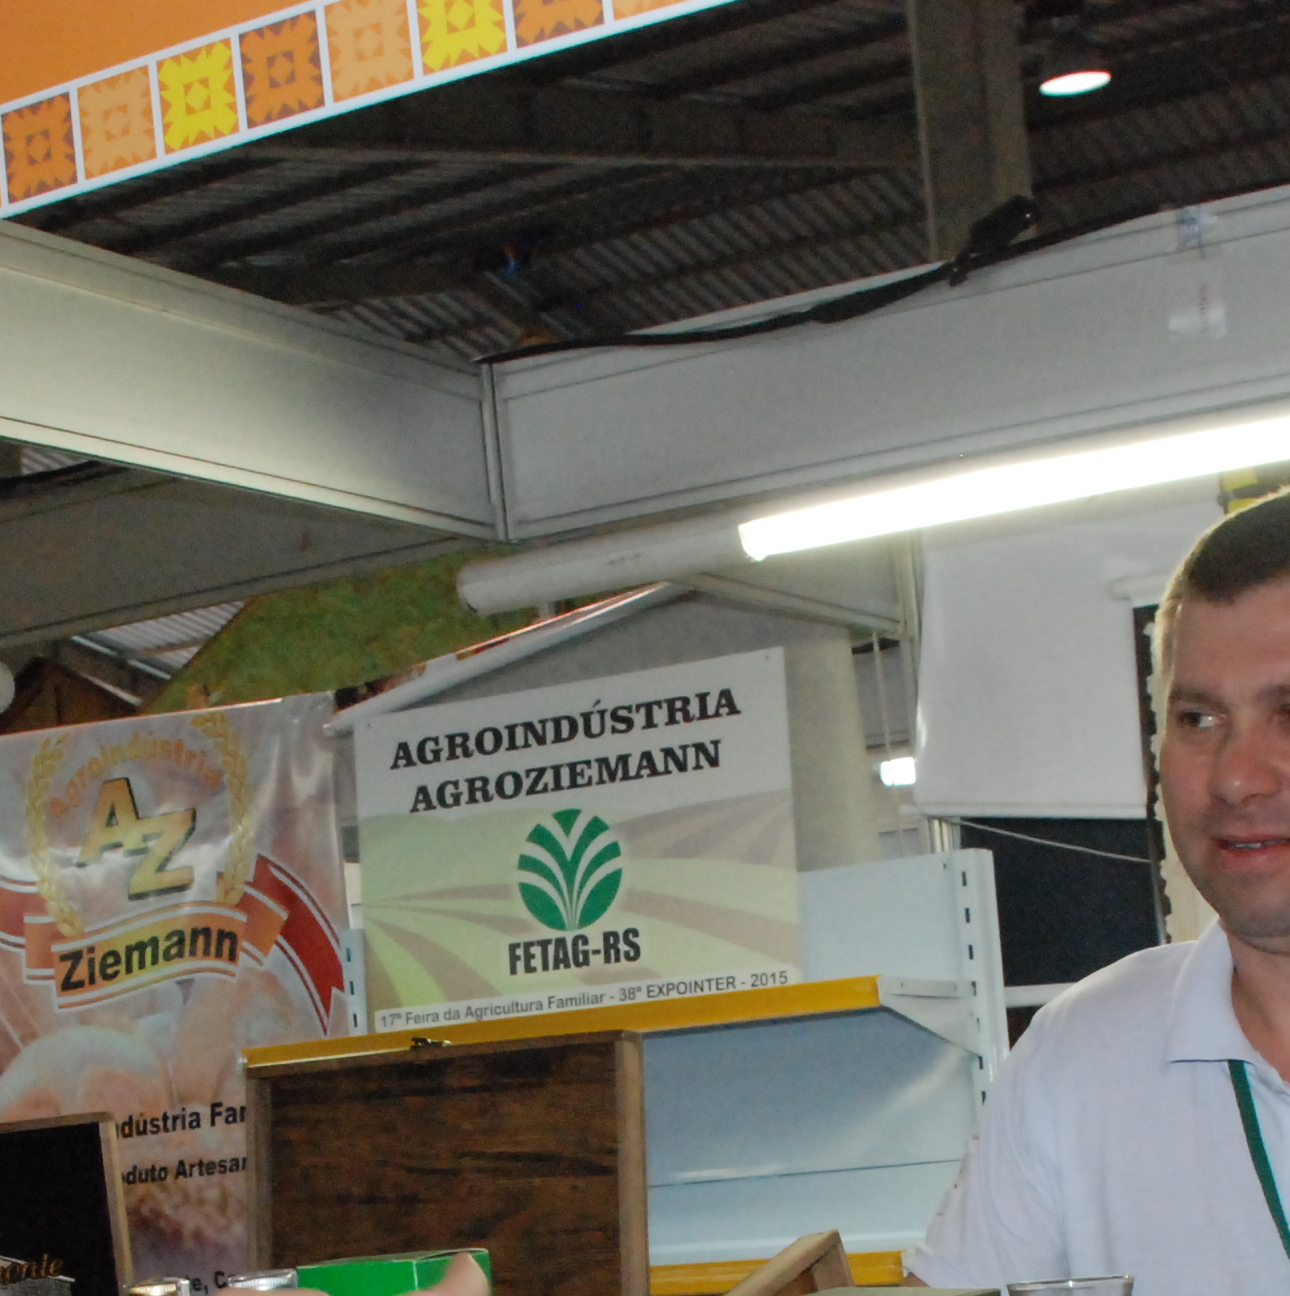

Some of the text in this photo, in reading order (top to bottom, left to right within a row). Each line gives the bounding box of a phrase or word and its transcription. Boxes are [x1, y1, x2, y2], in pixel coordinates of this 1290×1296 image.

[390, 688, 742, 770] AGROINDÚSTRIA
[410, 739, 722, 813] AGROZIEMANN
[59, 926, 239, 992] Ziemann
[509, 928, 642, 975] FETAG-RS
[406, 1008, 440, 1025] Feira
[444, 1006, 462, 1022] da
[464, 998, 545, 1024] Agricultura
[548, 990, 606, 1012] Familiar
[646, 975, 737, 999] EXPOINTER
[751, 970, 789, 988] 2015
